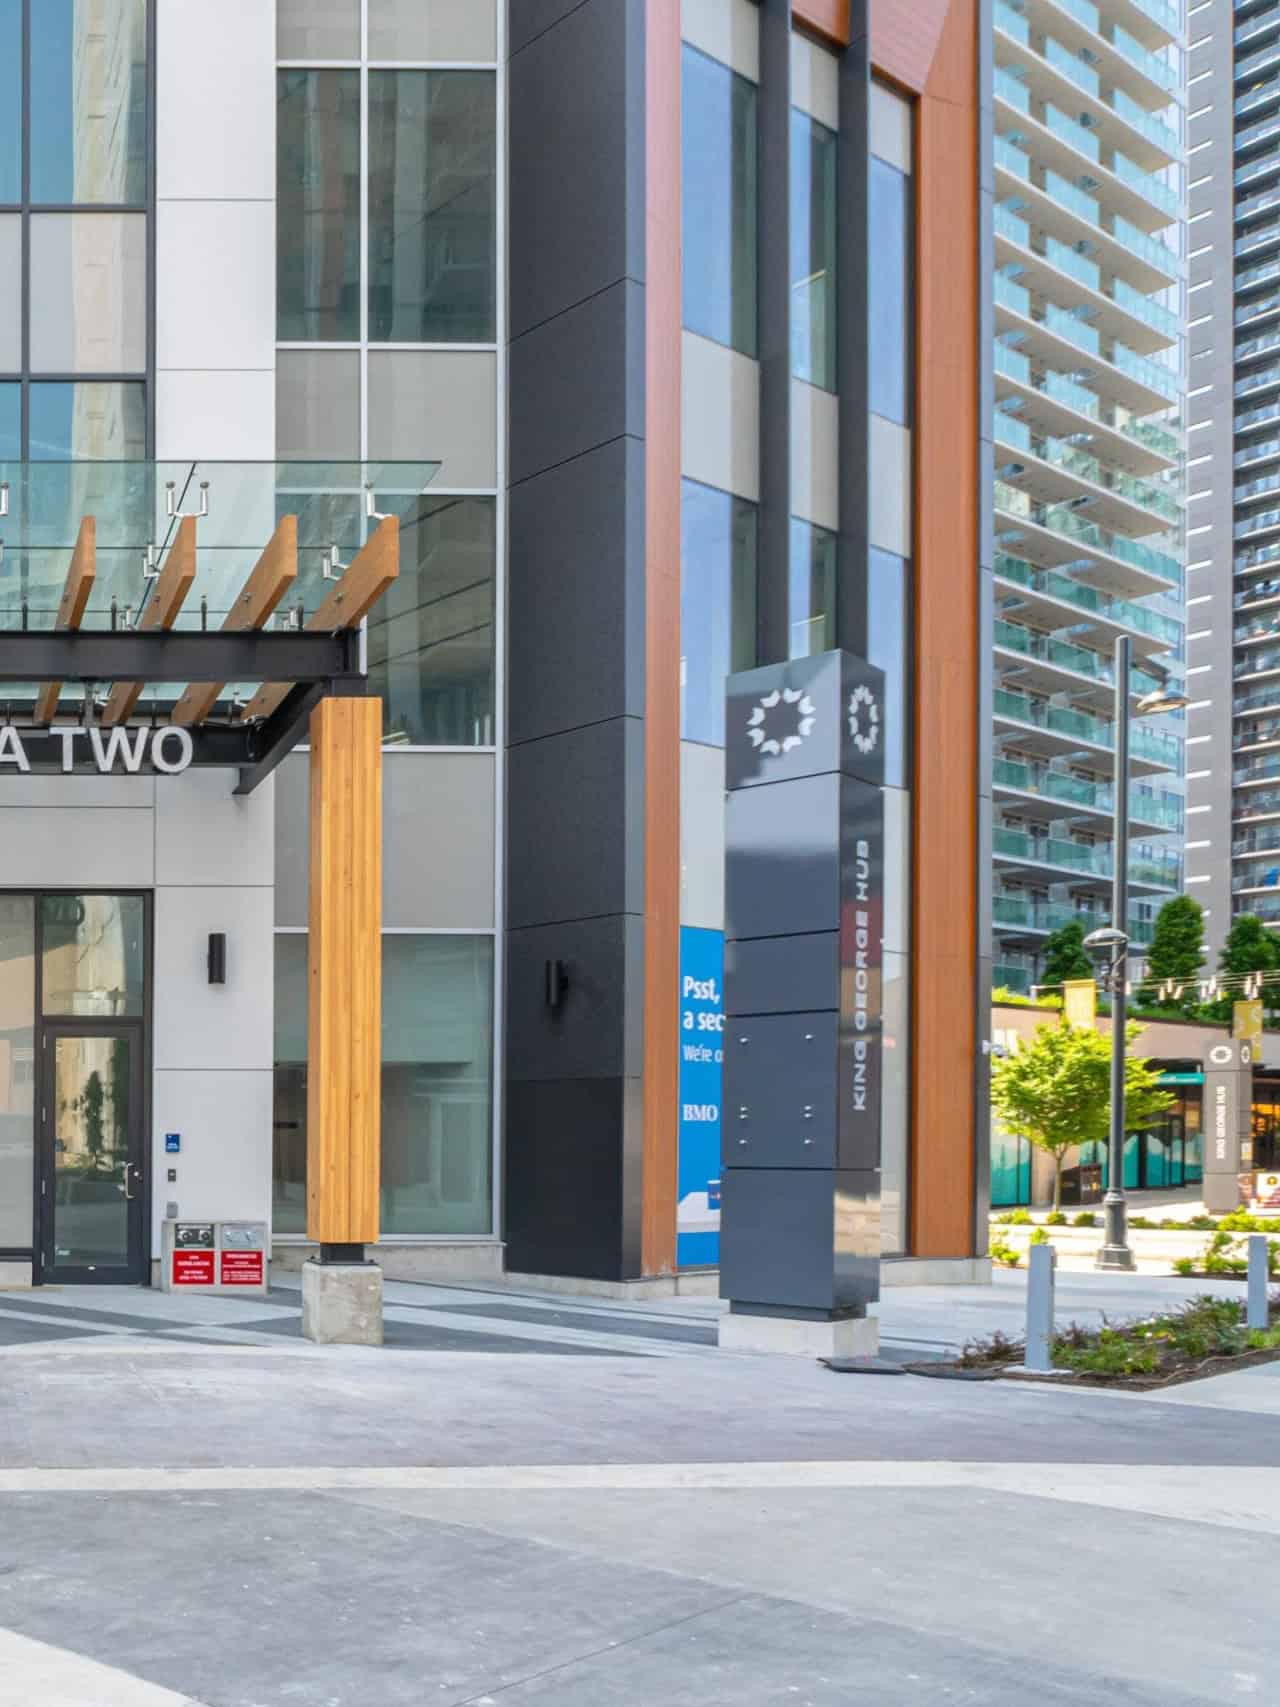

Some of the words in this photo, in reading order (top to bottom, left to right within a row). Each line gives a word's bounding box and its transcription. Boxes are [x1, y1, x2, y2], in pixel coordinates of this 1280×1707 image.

[49, 725, 194, 773] TWO
[856, 840, 869, 901] HUB
[683, 975, 721, 1004] Psst,
[854, 910, 869, 1031] GEORGE
[683, 1010, 694, 1030] a
[683, 1043, 712, 1062] We're
[853, 1040, 867, 1111] KING
[683, 1103, 719, 1121] BMO
